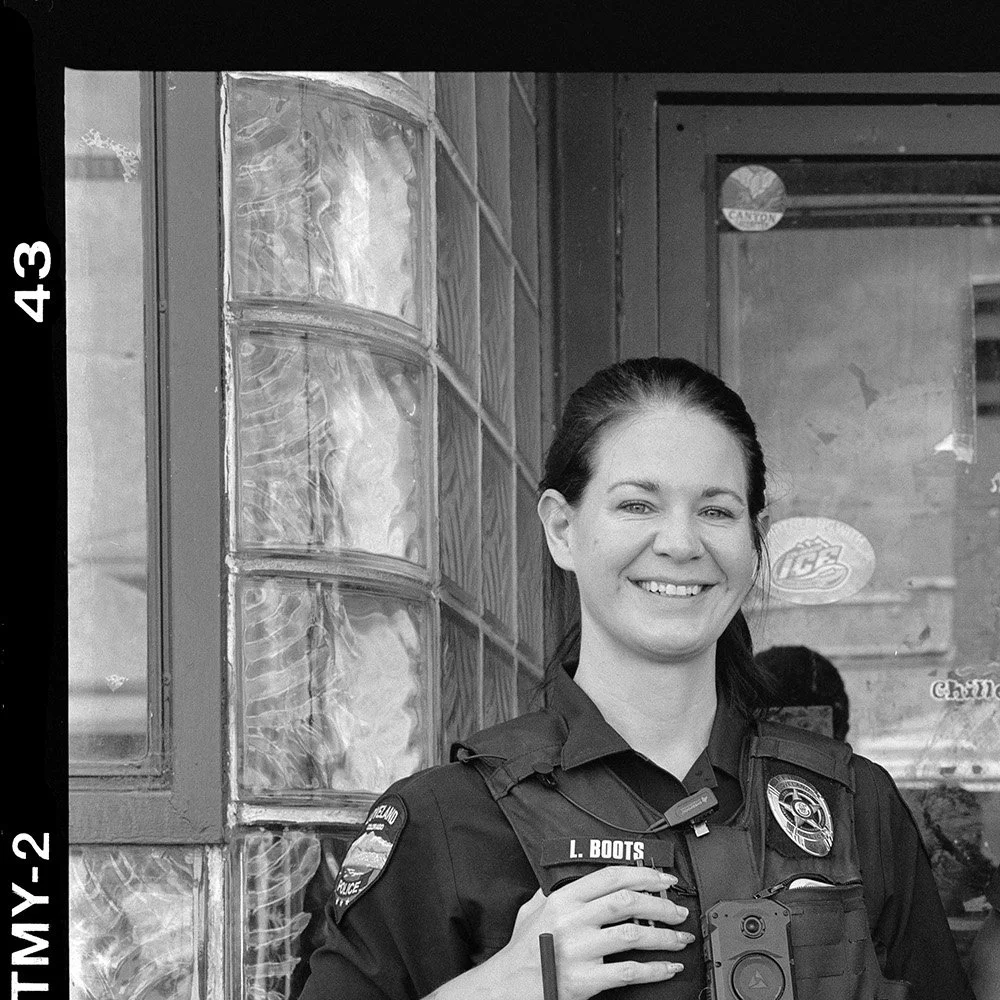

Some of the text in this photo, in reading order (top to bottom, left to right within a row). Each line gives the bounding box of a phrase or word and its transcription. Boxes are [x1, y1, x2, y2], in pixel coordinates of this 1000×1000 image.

[14, 241, 51, 322] 43
[778, 545, 843, 580] ICE
[569, 839, 645, 861] L. BOOTS
[336, 880, 361, 896] POLICE
